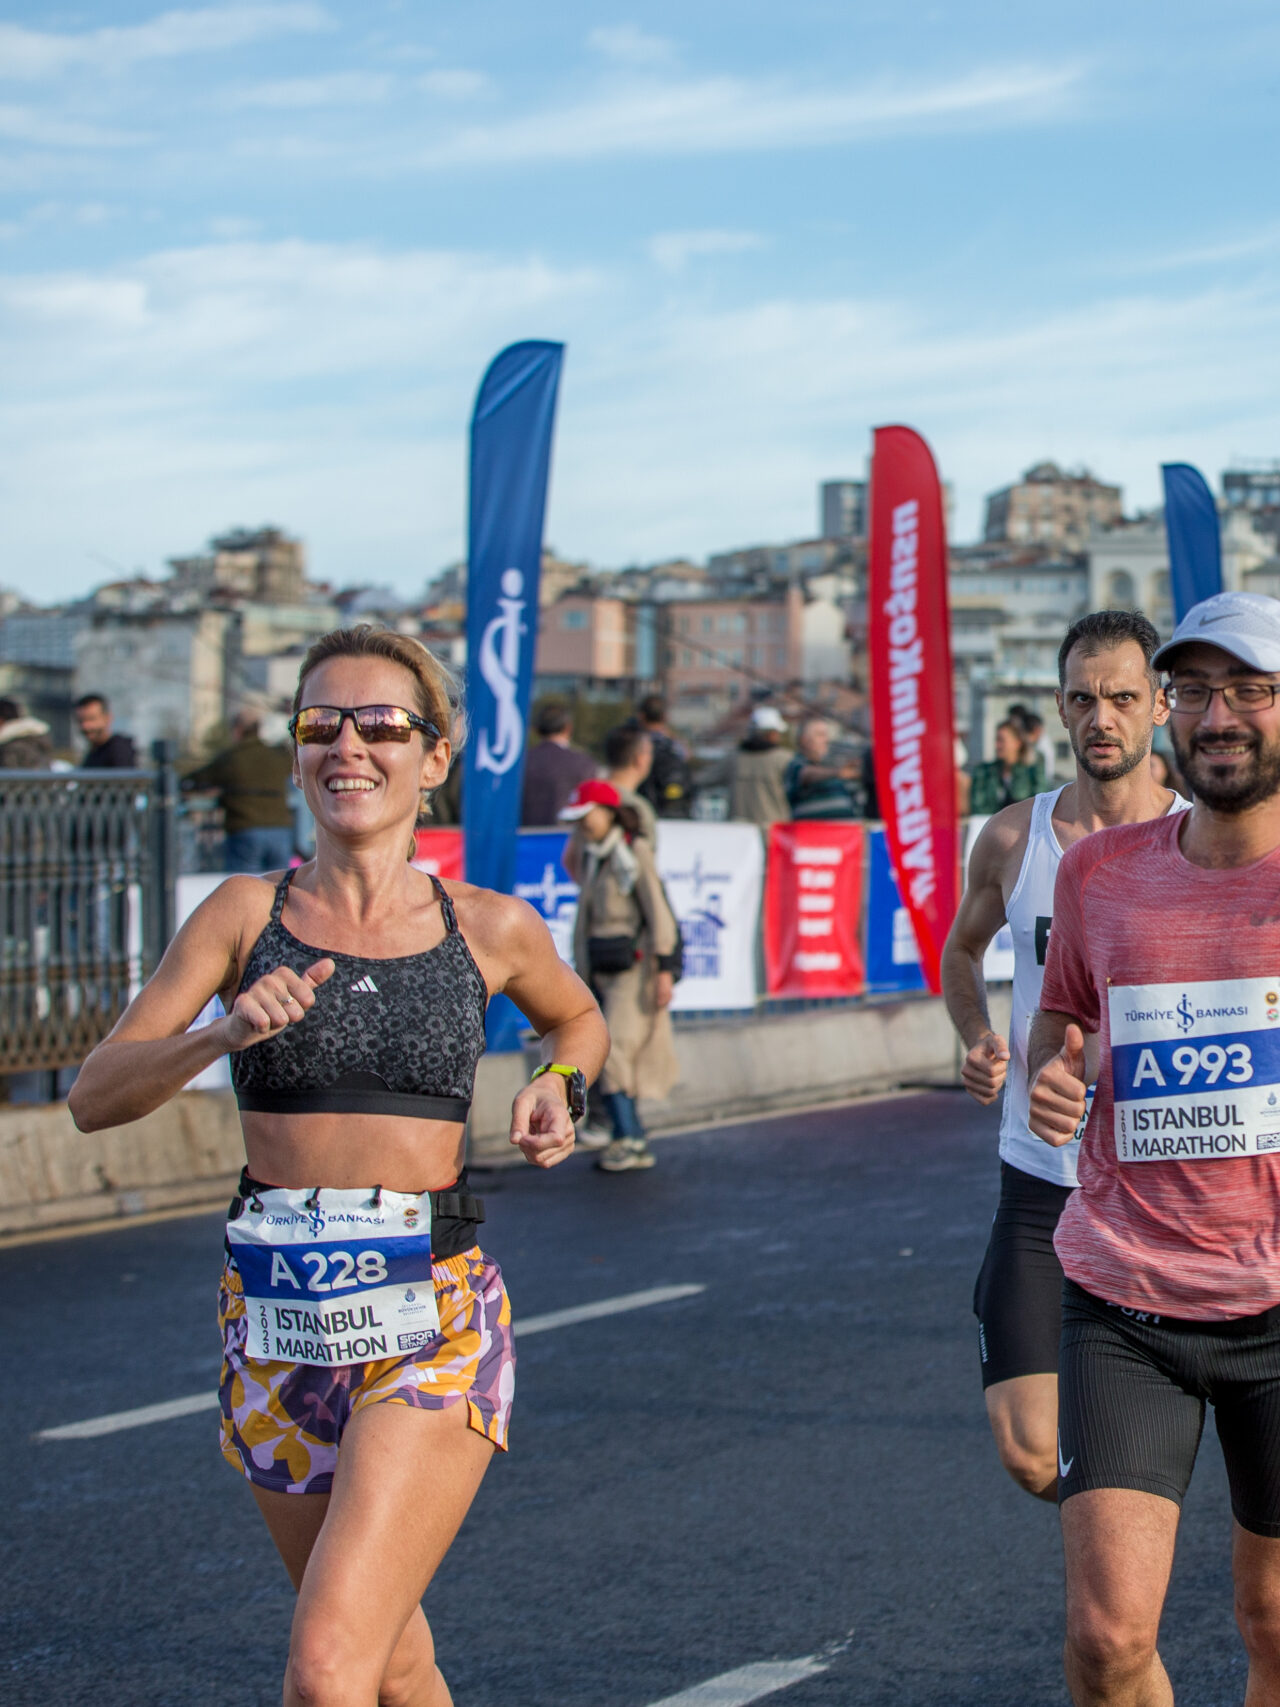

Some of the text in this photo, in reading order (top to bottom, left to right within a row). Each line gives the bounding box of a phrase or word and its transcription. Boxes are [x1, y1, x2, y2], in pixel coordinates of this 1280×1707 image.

[1124, 1007, 1174, 1022] TÜRKİYE
[1196, 1006, 1248, 1019] BANKASI
[1132, 1043, 1254, 1088] A 993
[1132, 1104, 1245, 1132] ISTANBUL
[1132, 1133, 1247, 1158] MARATHON
[328, 1214, 386, 1225] BANKASI
[270, 1250, 389, 1293] A 228
[275, 1305, 383, 1336] ISTANBUL
[276, 1334, 388, 1363] MARATHON
[400, 1331, 434, 1344] SPOR
